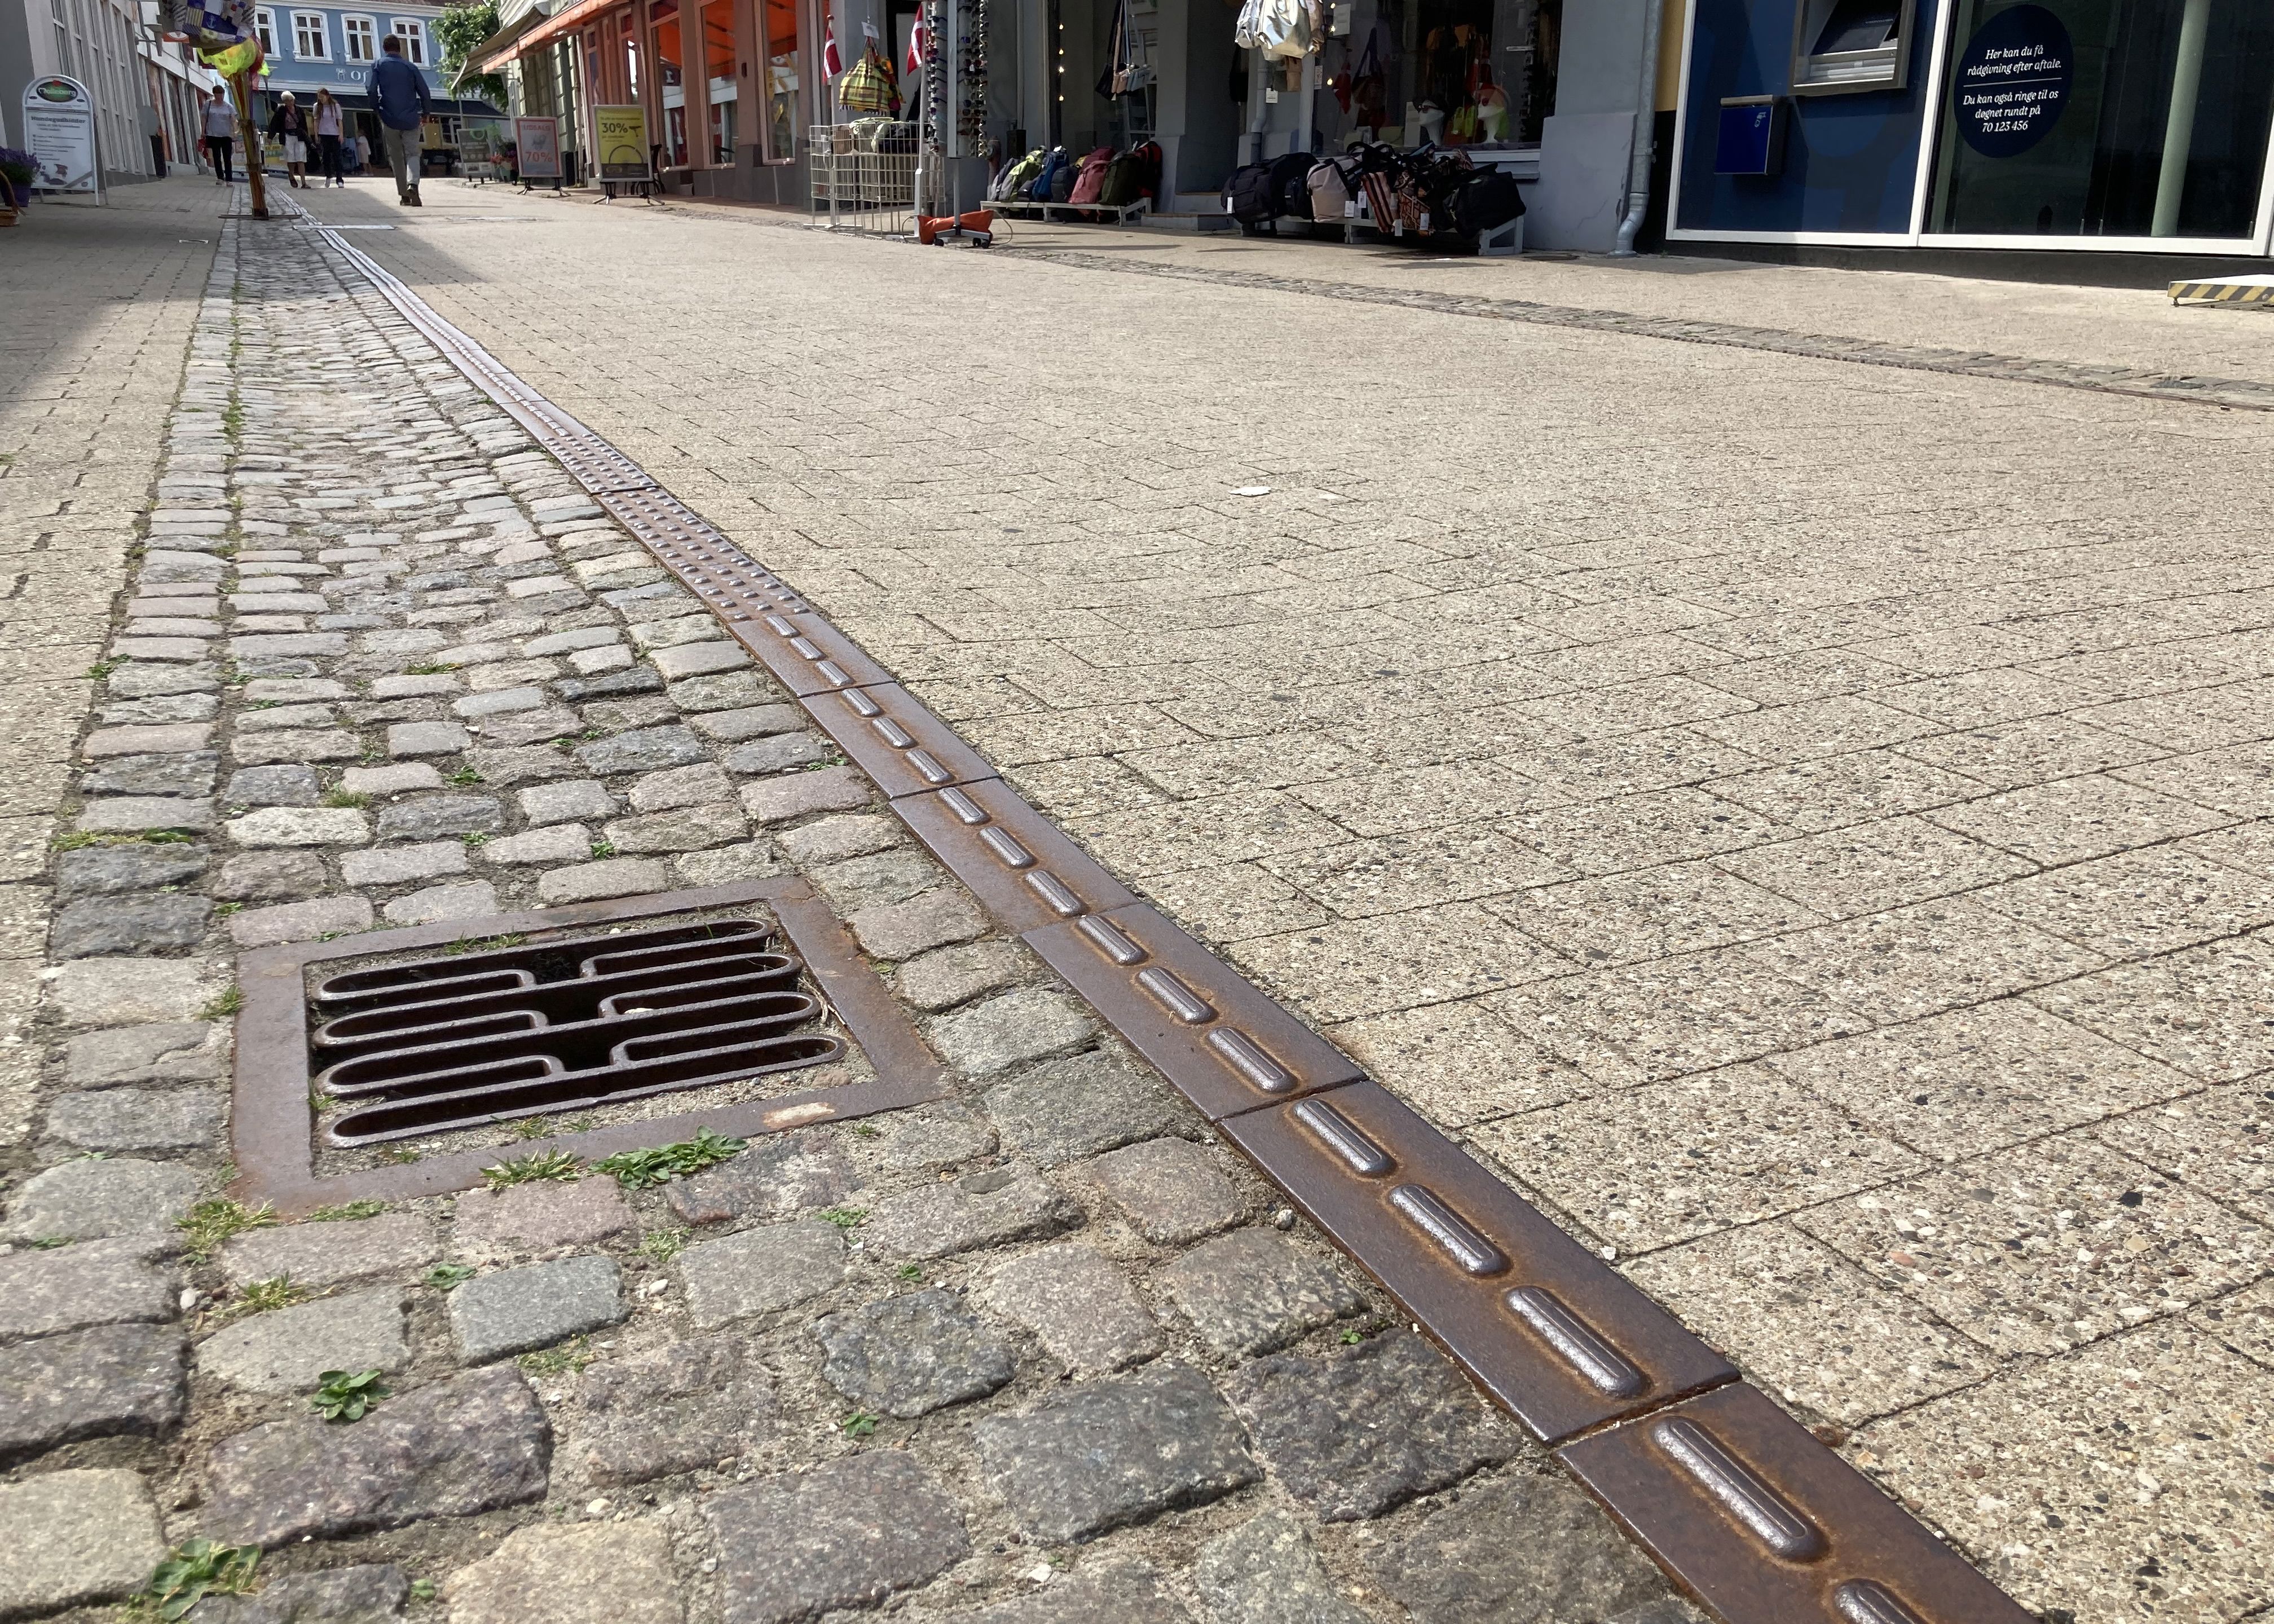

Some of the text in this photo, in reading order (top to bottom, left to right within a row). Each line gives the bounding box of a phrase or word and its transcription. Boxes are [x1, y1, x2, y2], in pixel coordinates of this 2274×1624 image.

[1985, 45, 2044, 60] Her kan du få
[1967, 59, 2061, 77] rådgivning efter aftale.
[1963, 95, 1975, 105] Du
[1976, 94, 1993, 104] kan
[1994, 92, 2012, 104] også
[2015, 91, 2037, 103] ringe
[2038, 90, 2048, 99] til
[2004, 106, 2028, 117] rundt
[2029, 105, 2041, 117] på
[602, 123, 629, 133] 30%
[1982, 120, 2029, 132] 70 123 456
[525, 151, 553, 163] 70%
